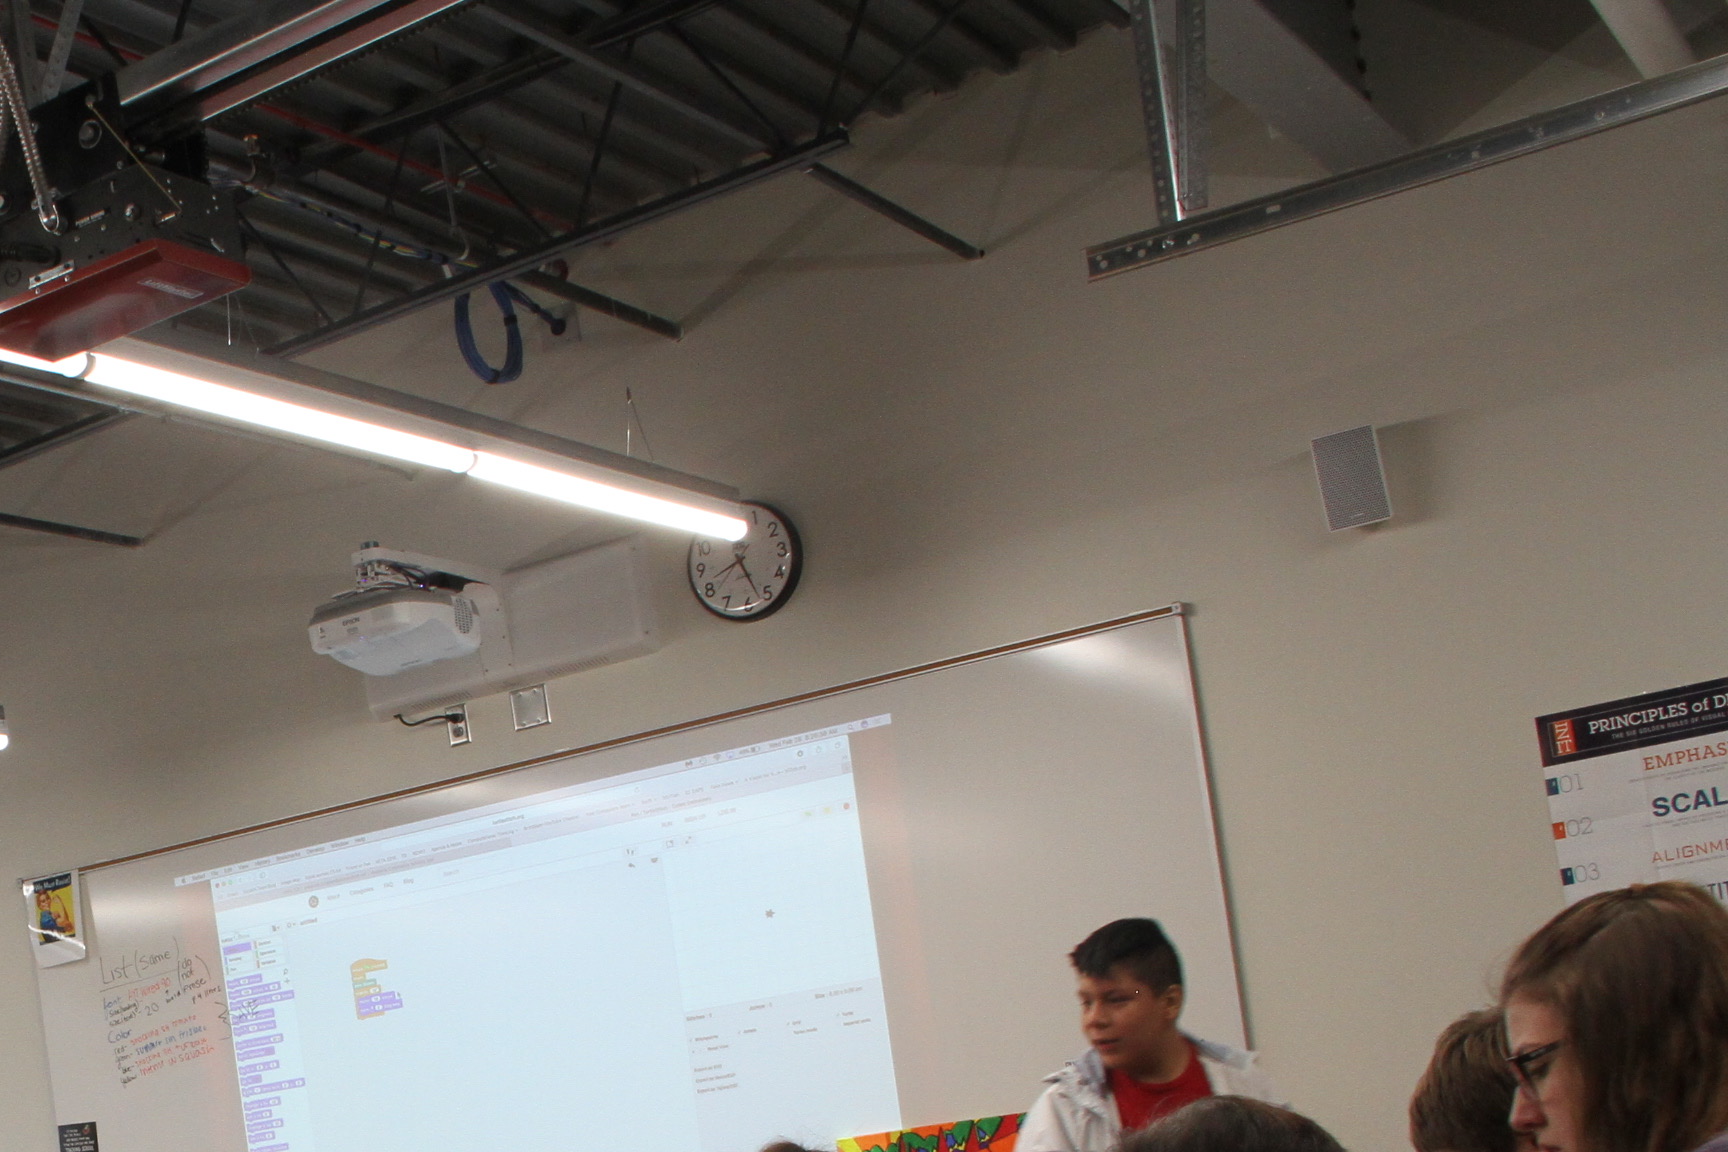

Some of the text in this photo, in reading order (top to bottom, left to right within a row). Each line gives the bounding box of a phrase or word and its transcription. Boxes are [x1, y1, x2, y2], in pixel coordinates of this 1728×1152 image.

[767, 521, 779, 538] 2
[776, 541, 788, 558] 3
[695, 562, 706, 579] 9
[773, 564, 786, 580] 4
[704, 582, 716, 598] 8
[762, 585, 773, 601] 5
[721, 594, 732, 612] 7
[1587, 702, 1688, 735] PRINCIPLES
[1691, 698, 1709, 713] of
[1643, 740, 1728, 771] EMPHAS
